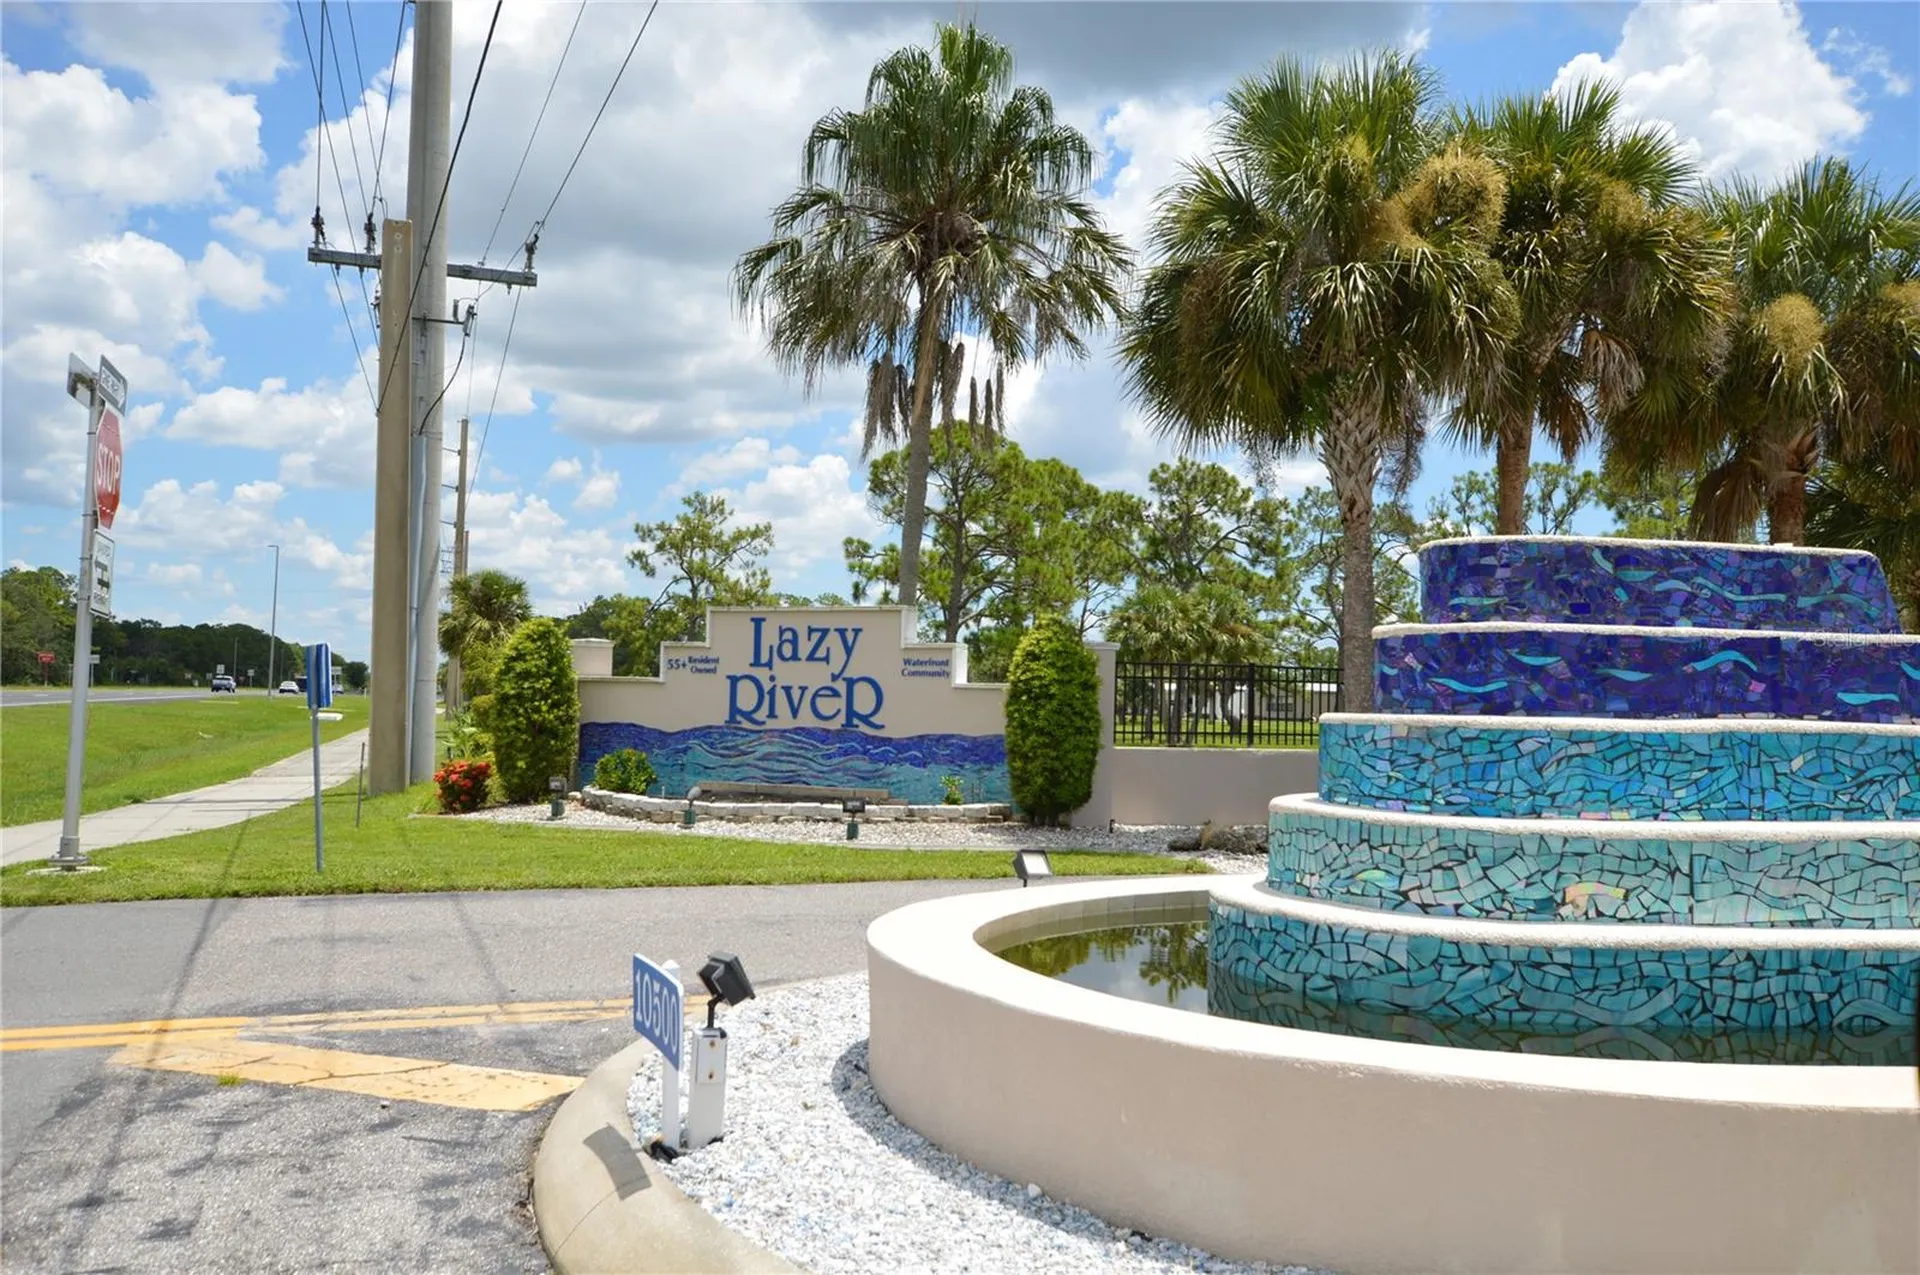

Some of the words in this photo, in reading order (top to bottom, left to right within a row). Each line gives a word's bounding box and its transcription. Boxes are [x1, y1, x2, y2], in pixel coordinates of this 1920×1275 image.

[97, 442, 120, 495] STOP
[749, 617, 863, 682] Lazy
[667, 658, 686, 670] 55+
[688, 656, 720, 664] Resident
[903, 658, 950, 666] Waterfront
[690, 665, 717, 674] Owned
[901, 668, 951, 678] Community
[635, 968, 678, 1056] 10500
